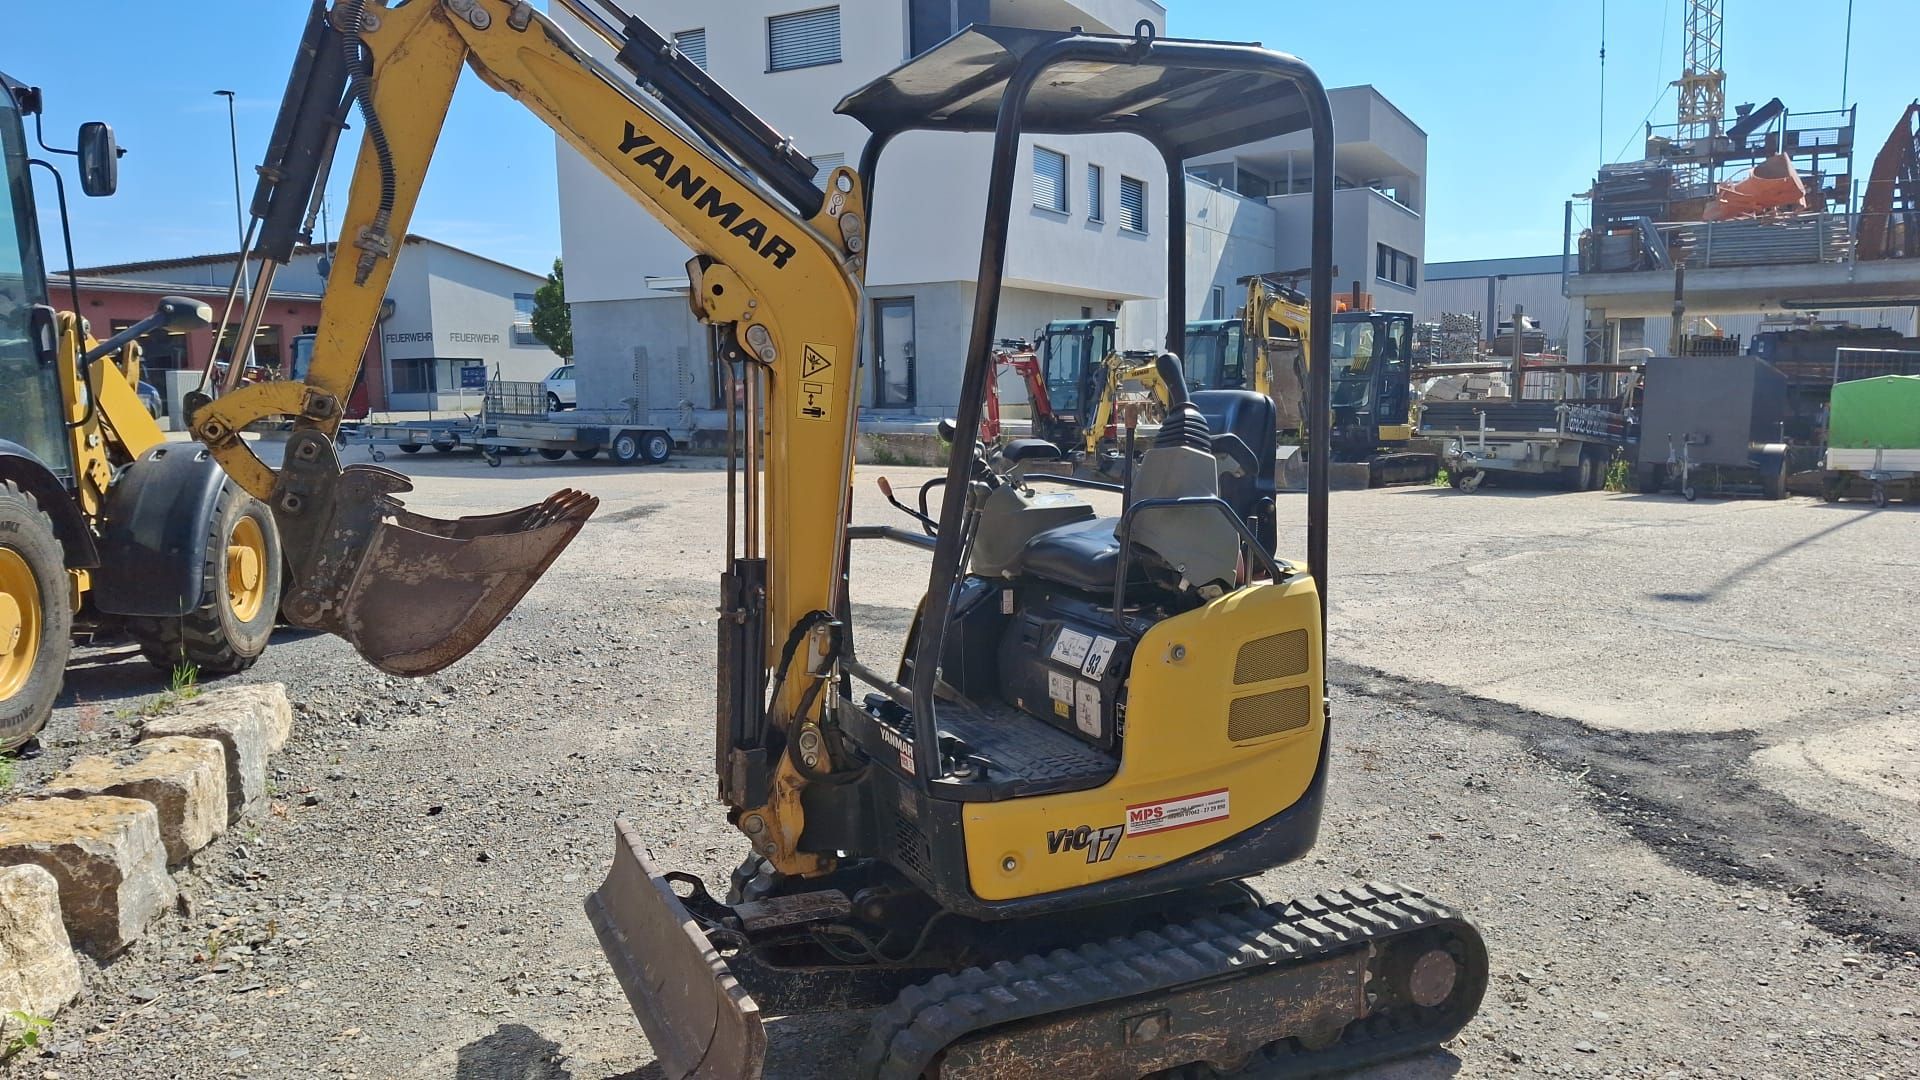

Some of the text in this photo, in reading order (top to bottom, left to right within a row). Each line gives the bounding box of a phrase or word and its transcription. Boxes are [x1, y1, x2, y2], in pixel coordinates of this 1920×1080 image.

[618, 120, 797, 270] YANMAR
[386, 332, 433, 344] FEUERWEHR
[449, 332, 500, 344] FEUERWEHR
[1086, 653, 1102, 676] 93
[880, 726, 914, 760] YANMAR
[1130, 806, 1164, 823] MPS
